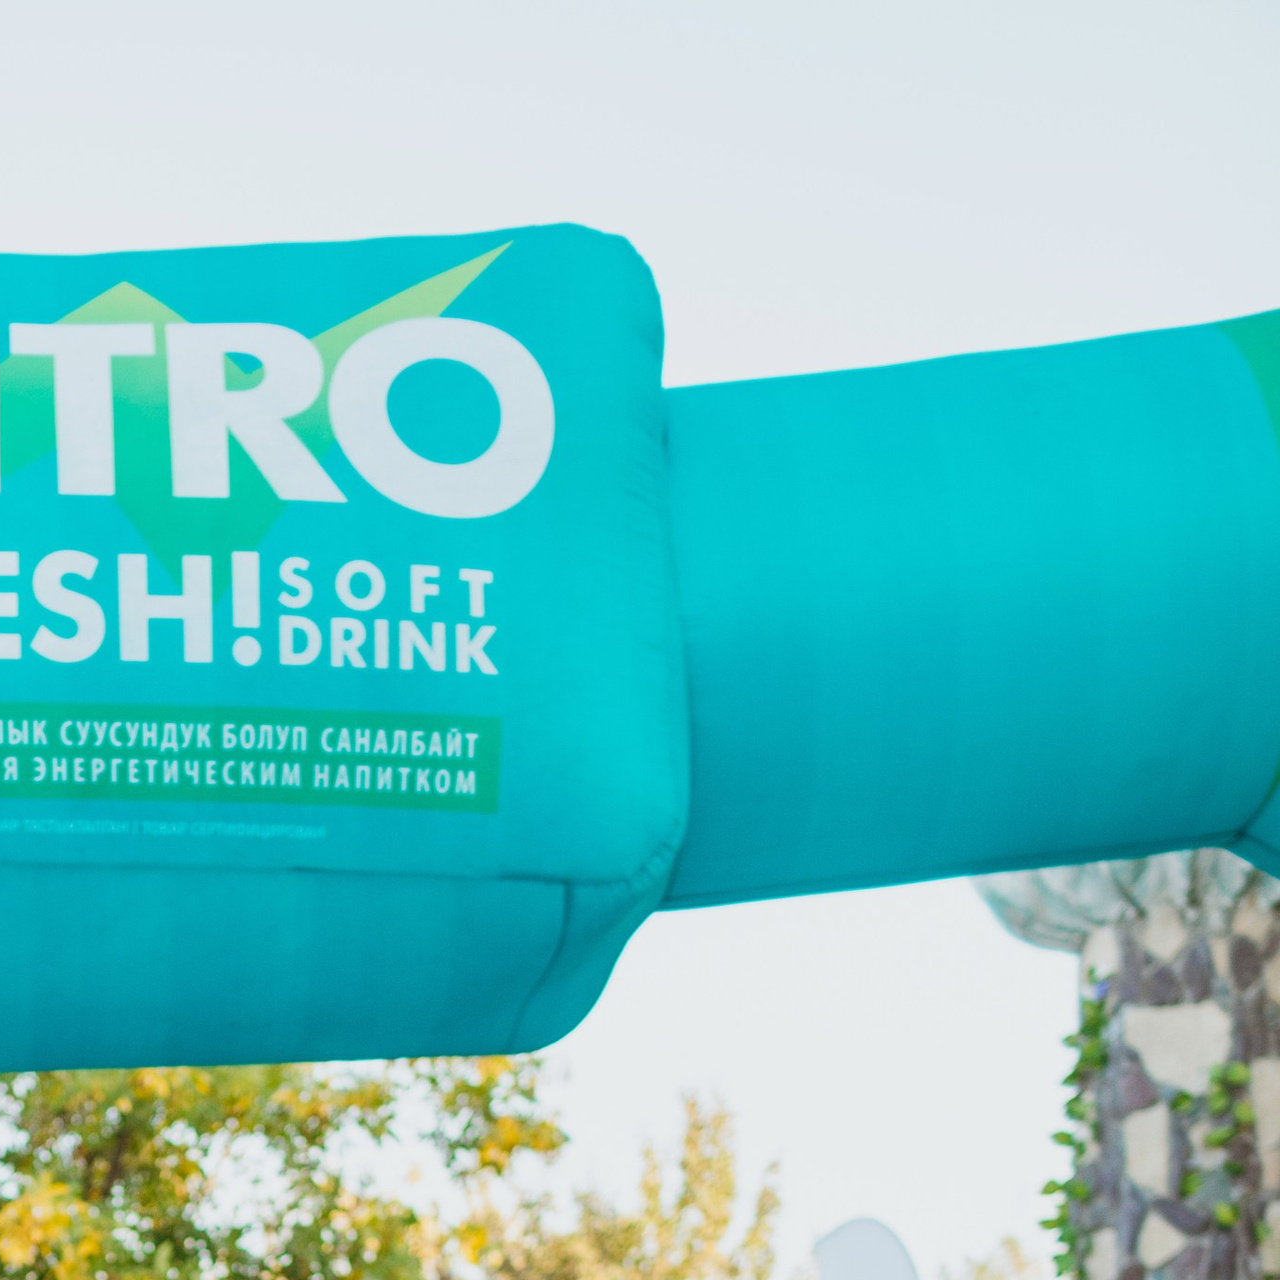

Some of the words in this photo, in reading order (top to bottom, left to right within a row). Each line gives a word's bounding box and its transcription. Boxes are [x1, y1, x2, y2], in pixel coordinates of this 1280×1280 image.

[278, 556, 494, 618] SOFT
[279, 614, 499, 675] DRINK
[60, 720, 210, 750] СУУСУНДУК
[223, 723, 307, 751] БОЛУП
[321, 727, 478, 758] САНАЛБАЙТ
[34, 757, 300, 785] ЭНЕРГЕТИЧЕСКИМ
[315, 765, 475, 794] НАПИТКОМ
